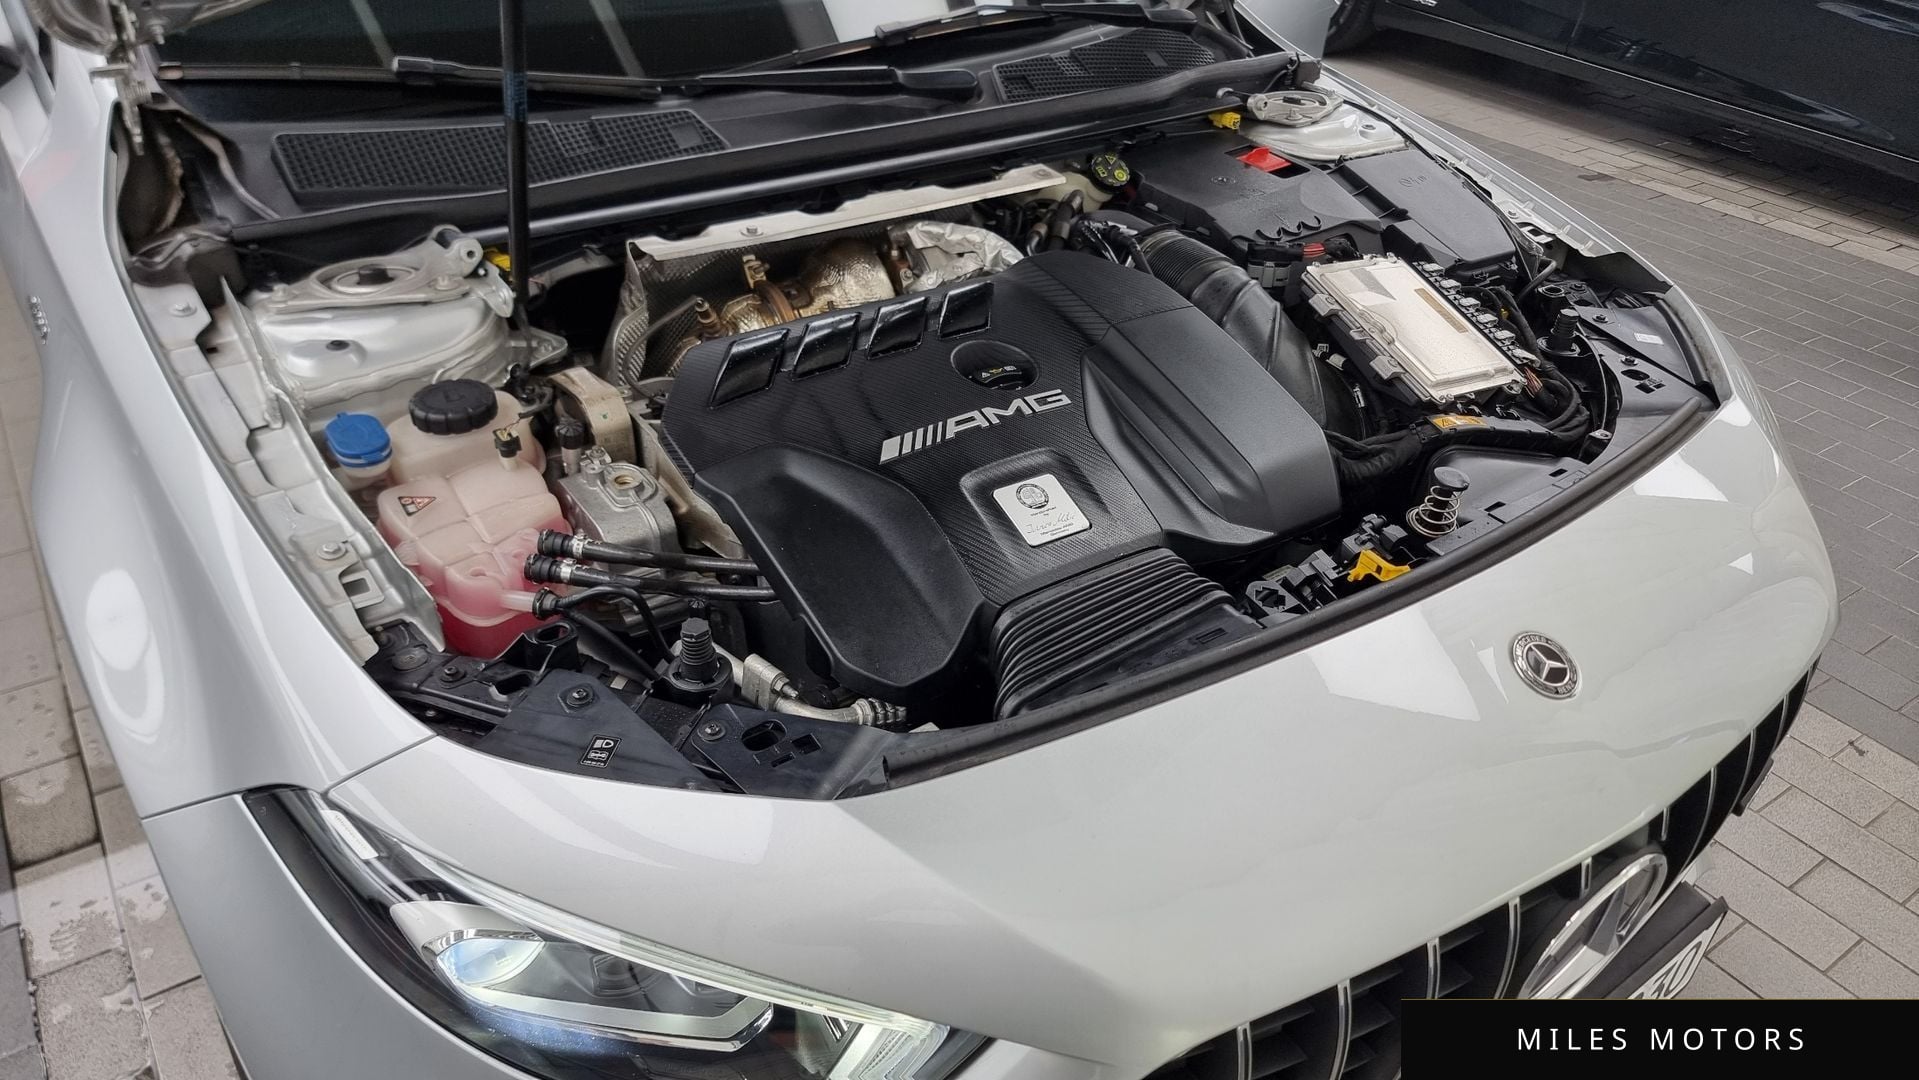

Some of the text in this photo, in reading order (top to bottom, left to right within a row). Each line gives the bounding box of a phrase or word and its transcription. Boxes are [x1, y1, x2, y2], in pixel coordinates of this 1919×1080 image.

[945, 389, 1072, 440] AMG
[1557, 680, 1575, 695] BENZ
[1633, 940, 1703, 998] 30
